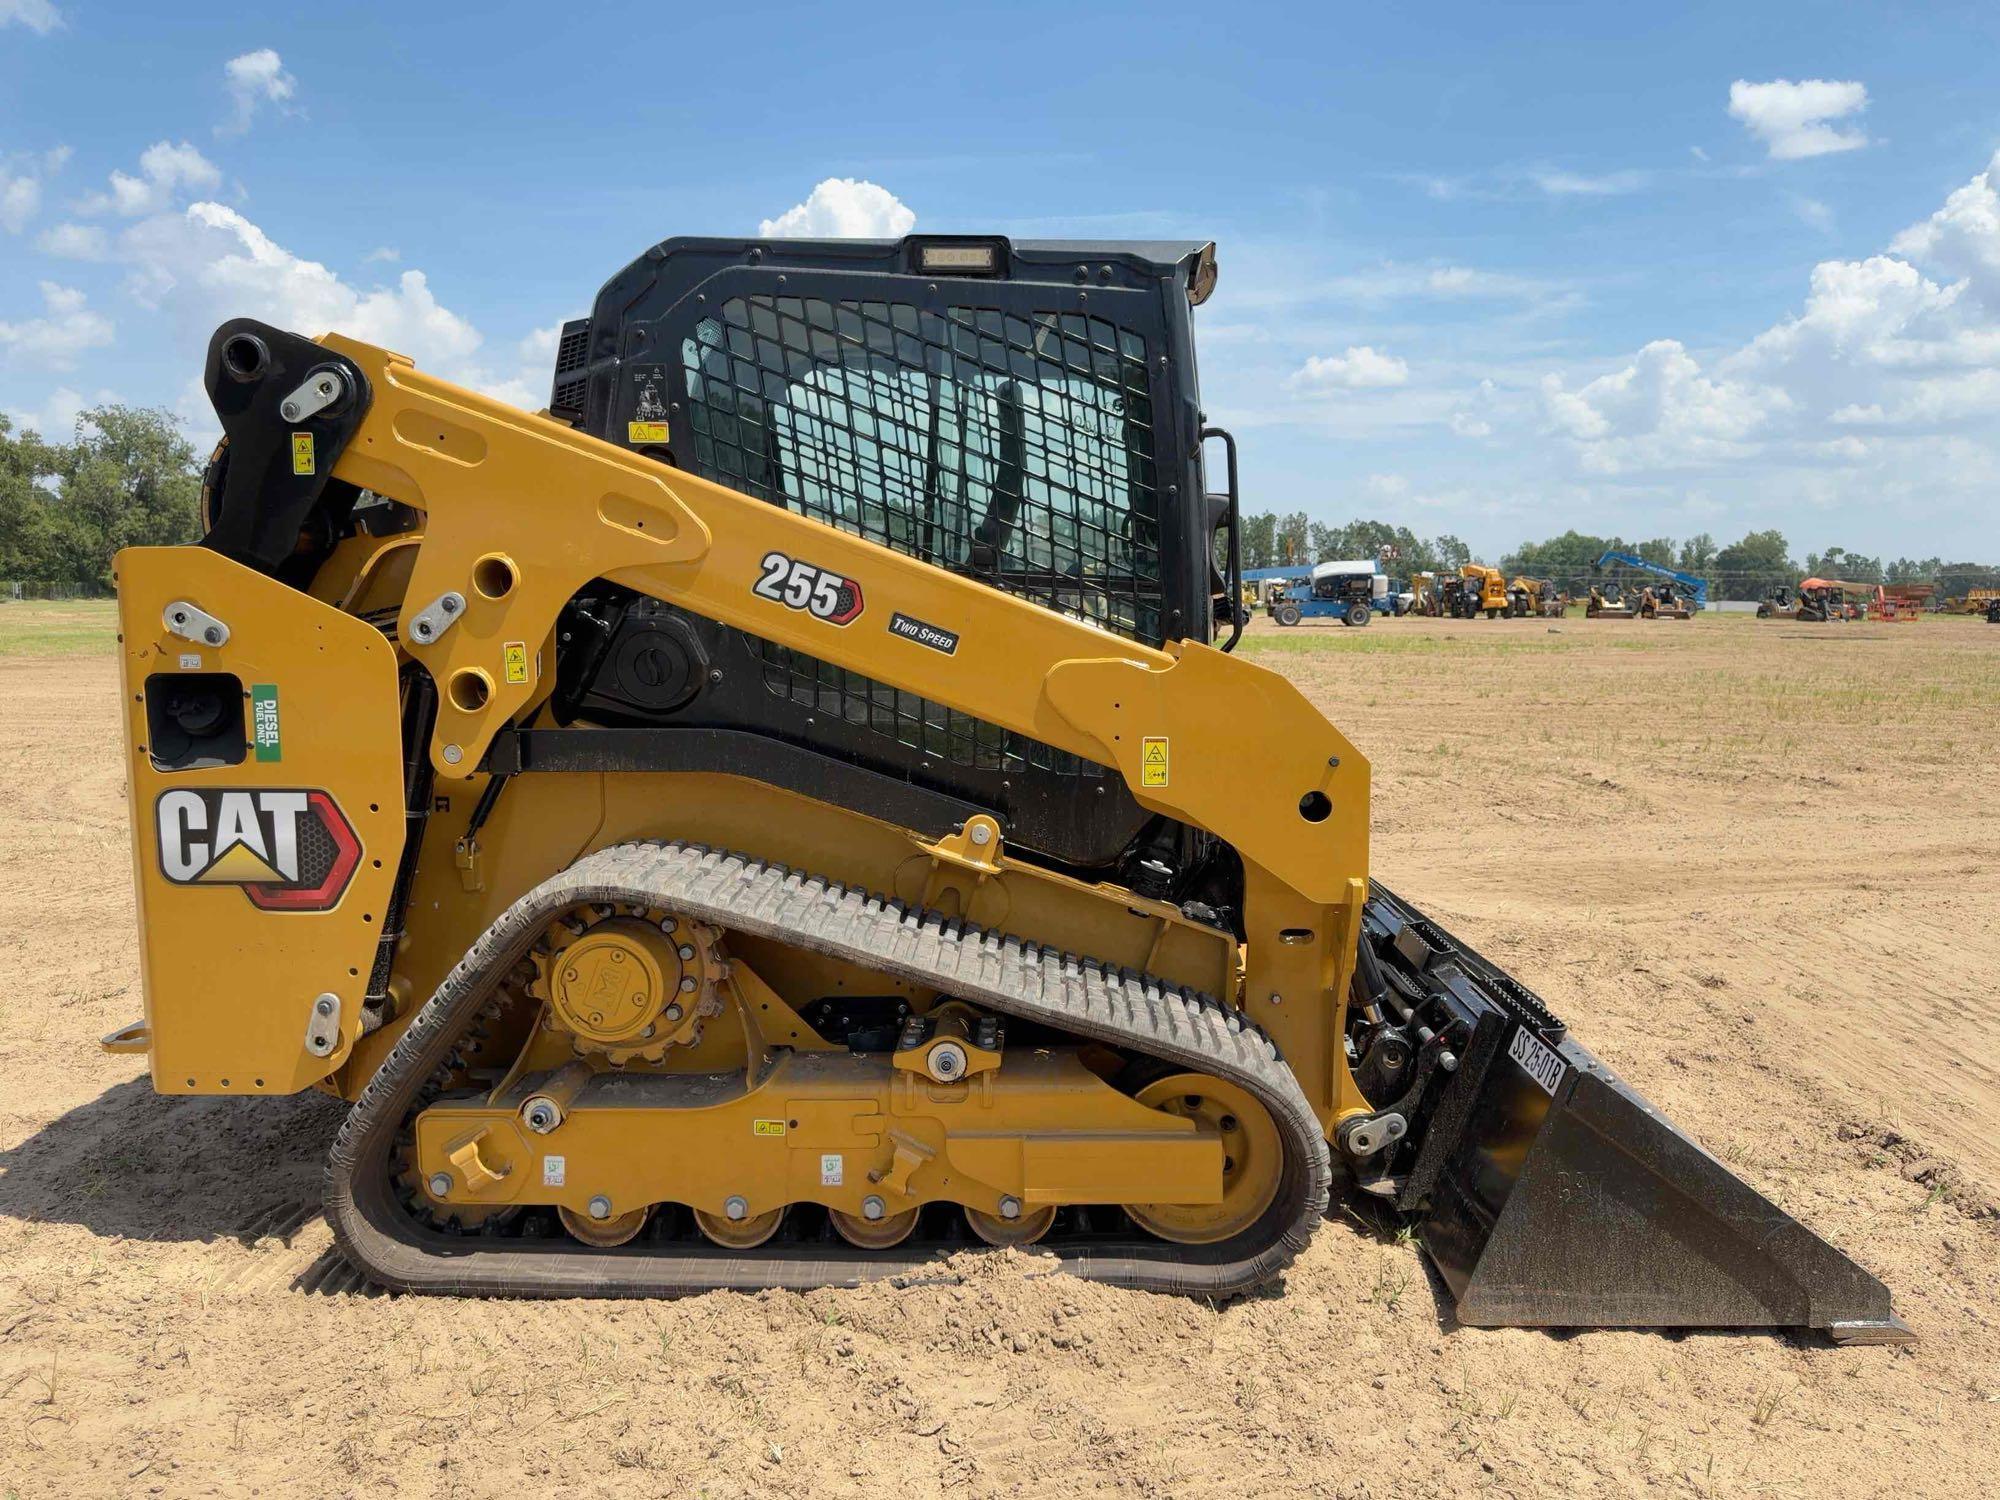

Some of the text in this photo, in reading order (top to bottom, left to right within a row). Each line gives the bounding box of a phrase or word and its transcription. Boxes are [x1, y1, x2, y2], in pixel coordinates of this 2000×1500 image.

[756, 554, 843, 617] 255
[255, 702, 266, 745] FUEL ONLY
[263, 699, 279, 748] DIESEL
[158, 790, 308, 882] CAT
[1513, 1030, 1530, 1060] SS
